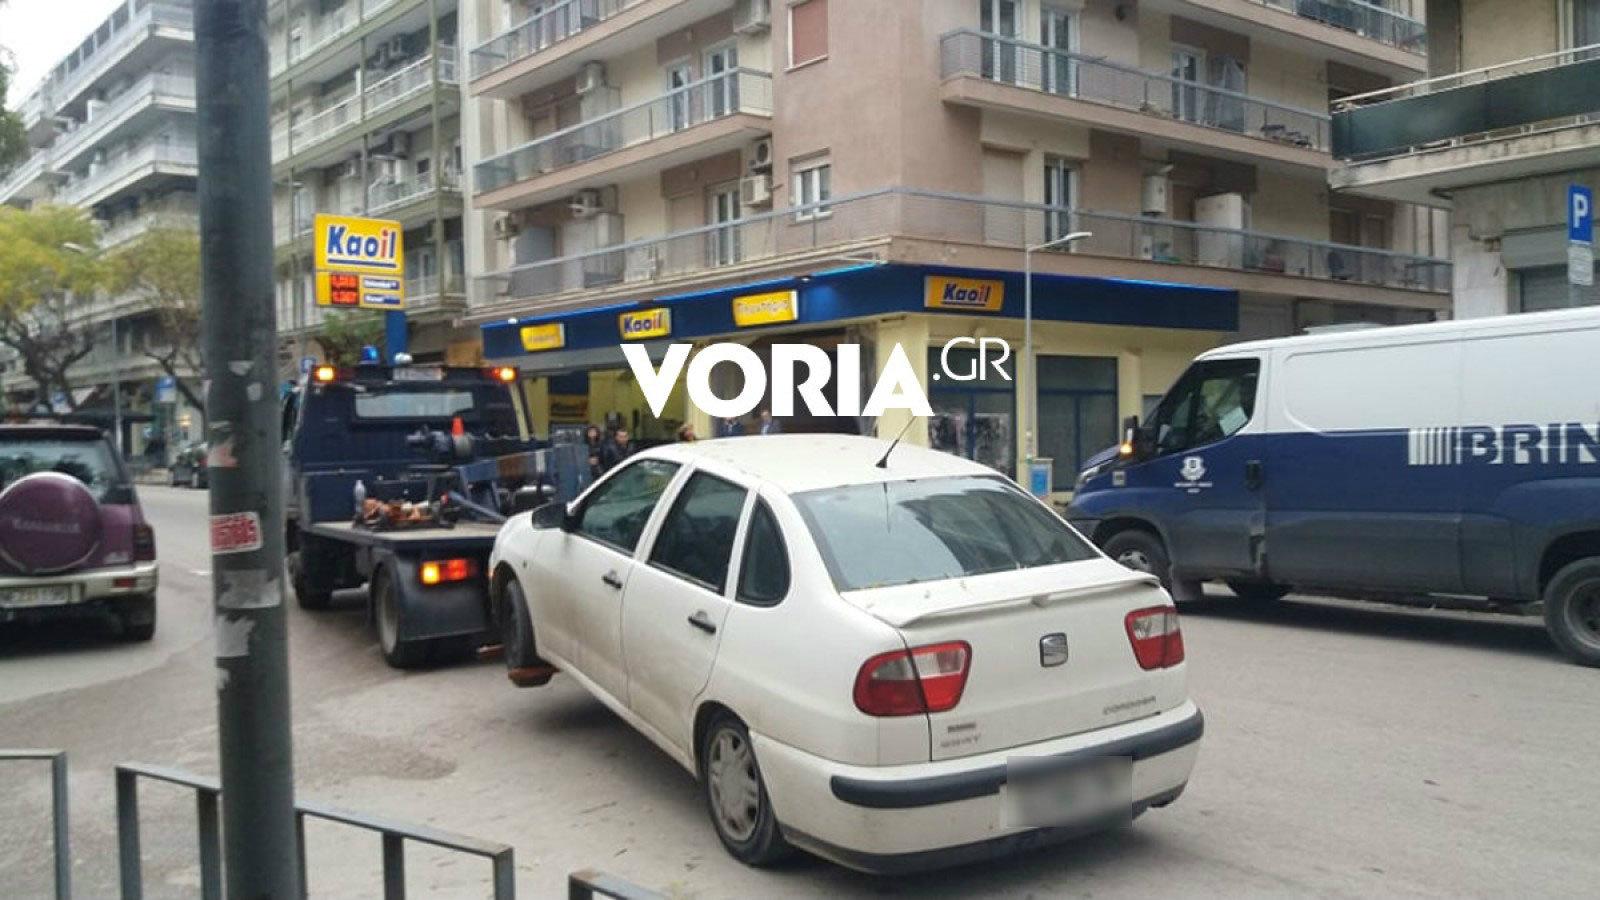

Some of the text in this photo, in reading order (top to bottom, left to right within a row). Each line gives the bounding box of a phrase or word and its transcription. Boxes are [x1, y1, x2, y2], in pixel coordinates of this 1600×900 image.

[1573, 193, 1589, 228] P
[327, 225, 397, 258] Kaoil
[943, 282, 990, 303] Kaoil
[623, 311, 662, 333] Kaoil
